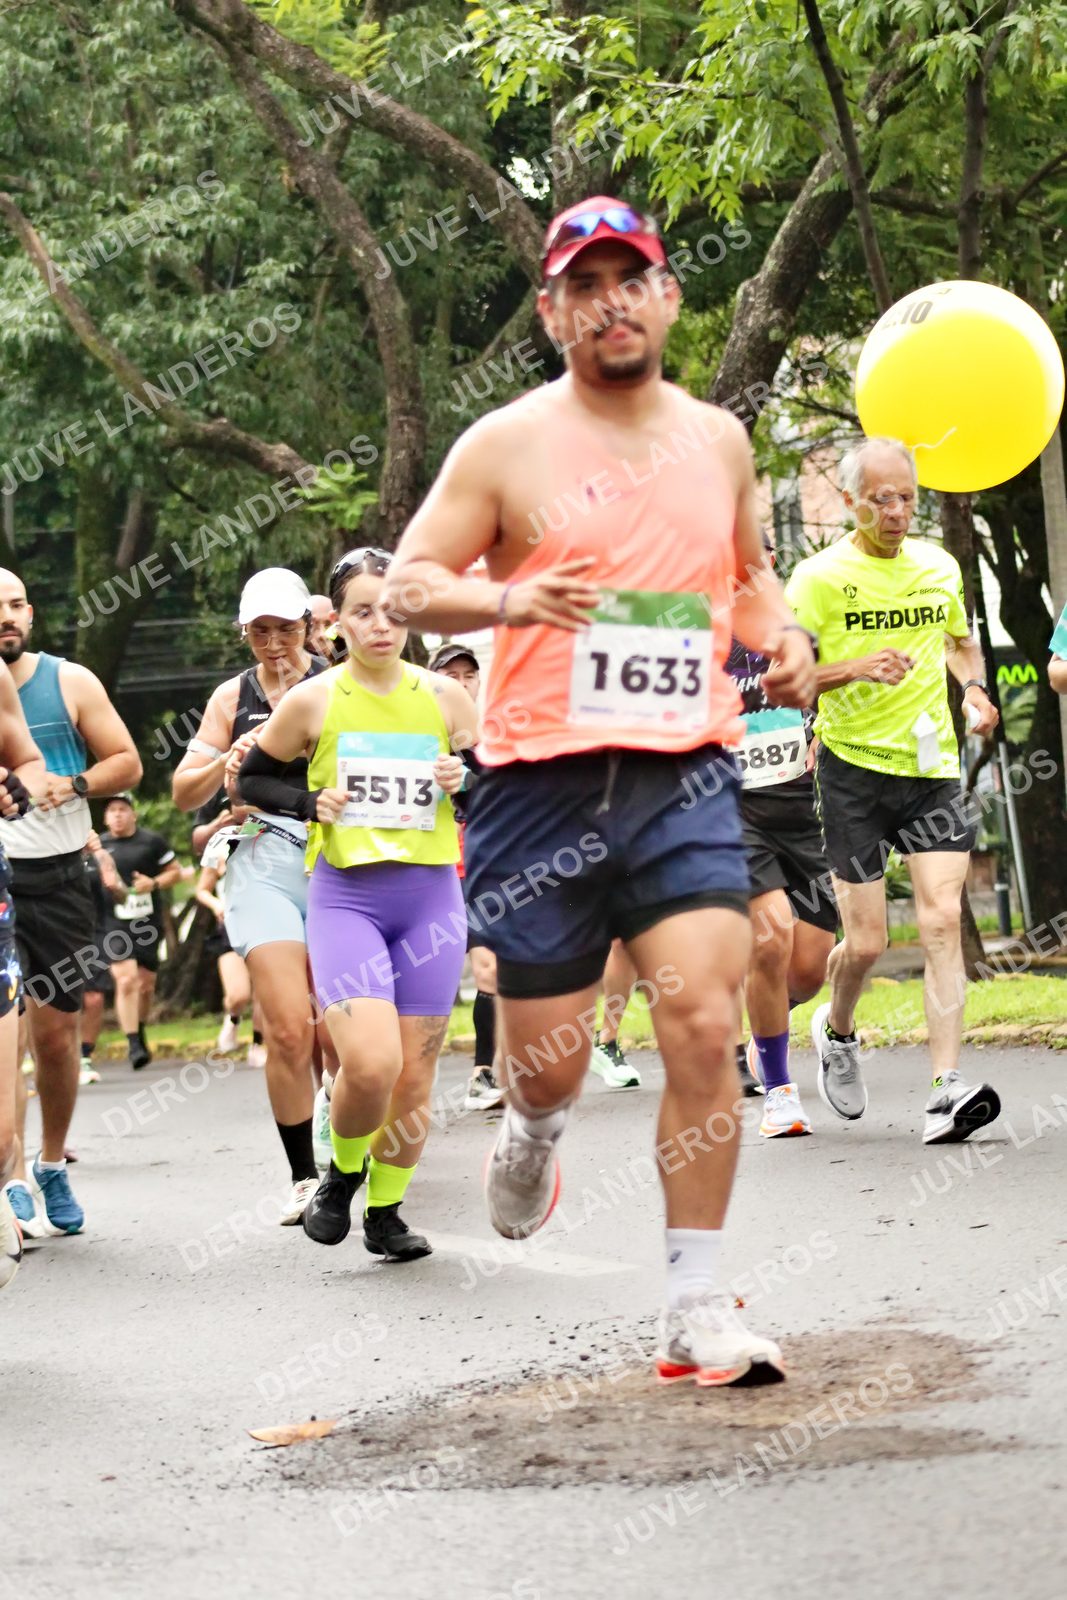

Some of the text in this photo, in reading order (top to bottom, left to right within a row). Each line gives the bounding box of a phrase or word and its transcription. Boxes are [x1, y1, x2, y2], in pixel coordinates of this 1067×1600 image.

[845, 605, 947, 631] PERDURA
[590, 651, 701, 697] 1633
[733, 740, 800, 772] 5887
[347, 775, 433, 807] 5513
